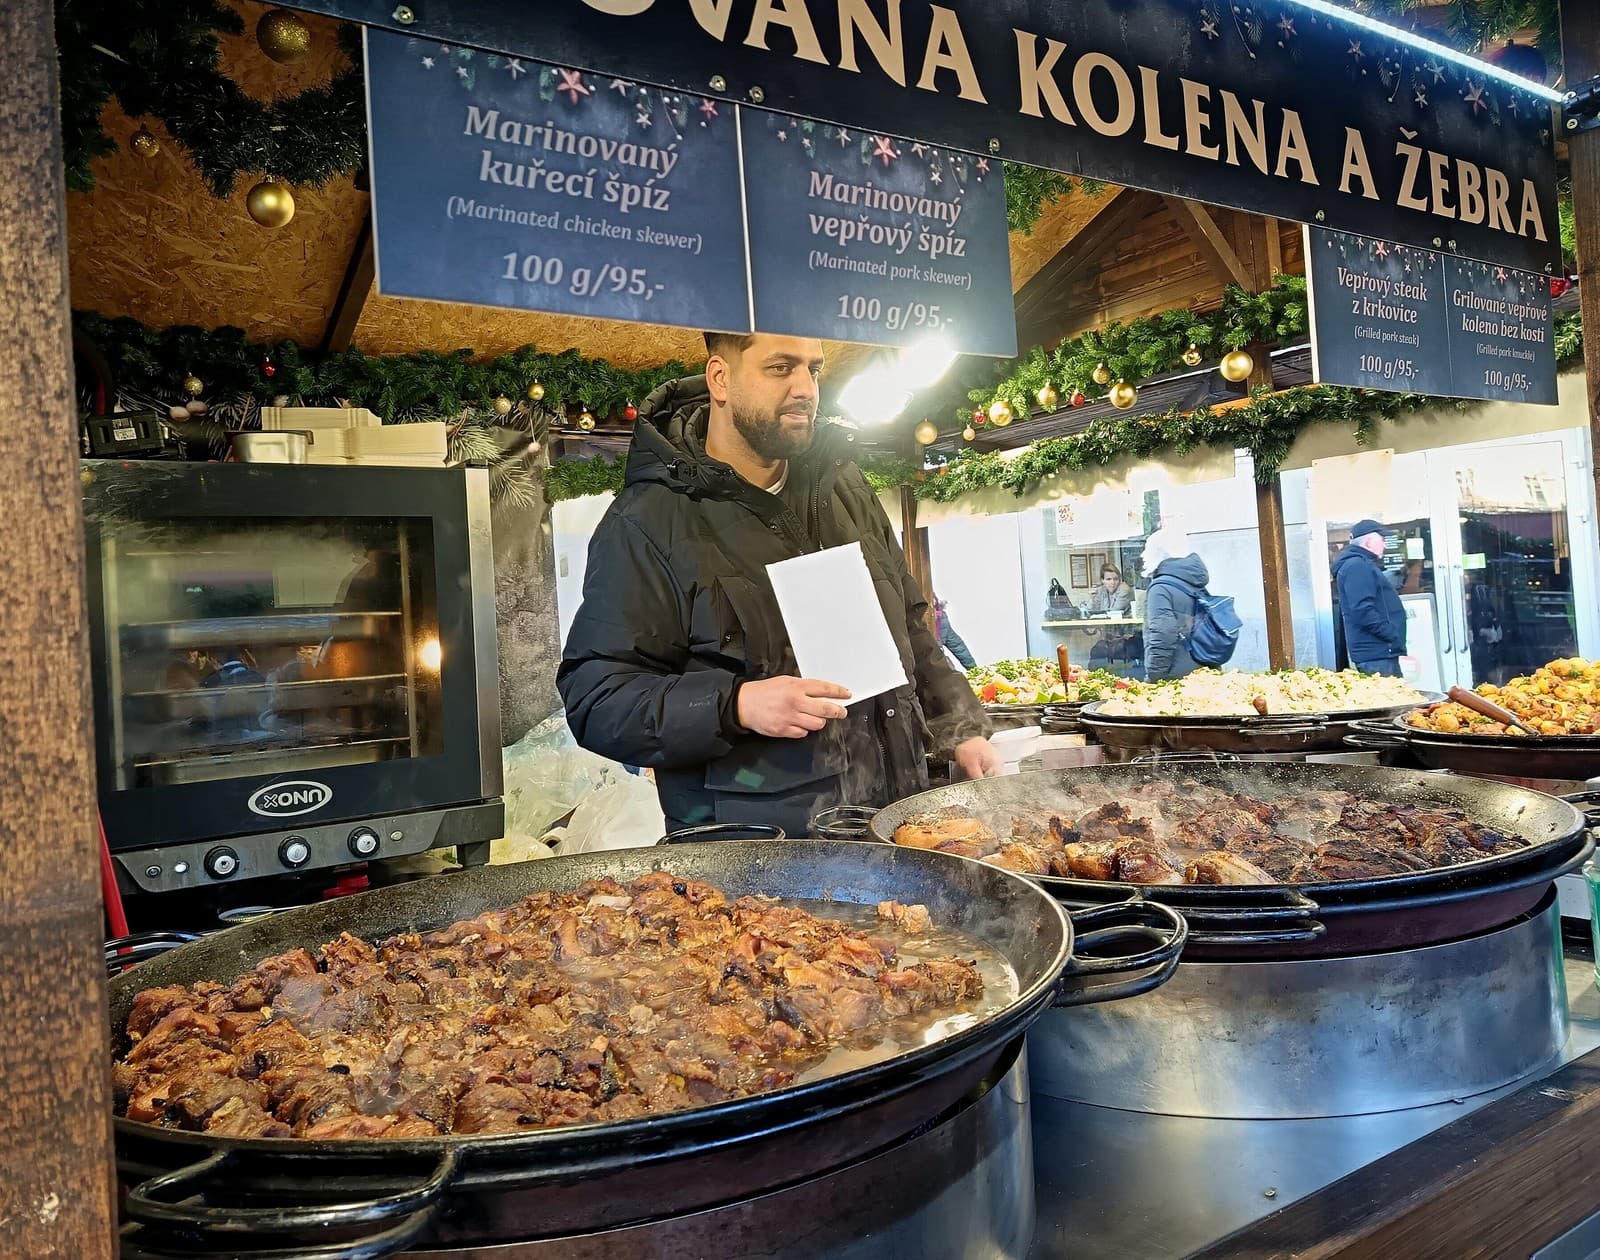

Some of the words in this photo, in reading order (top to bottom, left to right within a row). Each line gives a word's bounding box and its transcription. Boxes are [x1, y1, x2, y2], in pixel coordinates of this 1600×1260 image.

[463, 105, 679, 179] Marinovaný
[1012, 28, 1320, 186] KOLENA
[1338, 126, 1380, 200] A
[1395, 126, 1548, 242] ŽEBRA
[479, 150, 598, 199] kuřecí
[602, 171, 670, 213] špíz
[808, 171, 962, 228] Marinovaný
[446, 195, 560, 230] (Marinated
[563, 217, 632, 240] chicken
[635, 225, 703, 255] skewer)
[808, 213, 913, 255] vepřový
[918, 225, 967, 260] špíz
[501, 252, 564, 285] 100
[569, 263, 665, 300] g/95,-
[808, 249, 887, 276] (Marinated
[890, 265, 921, 281] pork
[923, 268, 972, 291] skewer)
[1337, 266, 1391, 298] Vepřový
[1393, 282, 1428, 302] steak
[837, 294, 881, 322] 100
[885, 302, 953, 332] g/95,-
[1352, 299, 1360, 315] z
[1363, 296, 1418, 324] krkovice
[1453, 289, 1506, 314] Grilované
[1508, 303, 1547, 322] vepřové
[1354, 325, 1381, 340] (Grilled
[1381, 330, 1398, 344] pork
[1399, 332, 1420, 348] steak)
[1462, 313, 1498, 336] koleno
[1500, 320, 1519, 339] bez
[1520, 323, 1545, 343] kosti
[1359, 354, 1382, 373] 100
[1383, 357, 1419, 380] g/95,-
[1484, 370, 1502, 386] 100
[1503, 373, 1532, 391] g/95,-
[263, 788, 323, 809] UNOX
